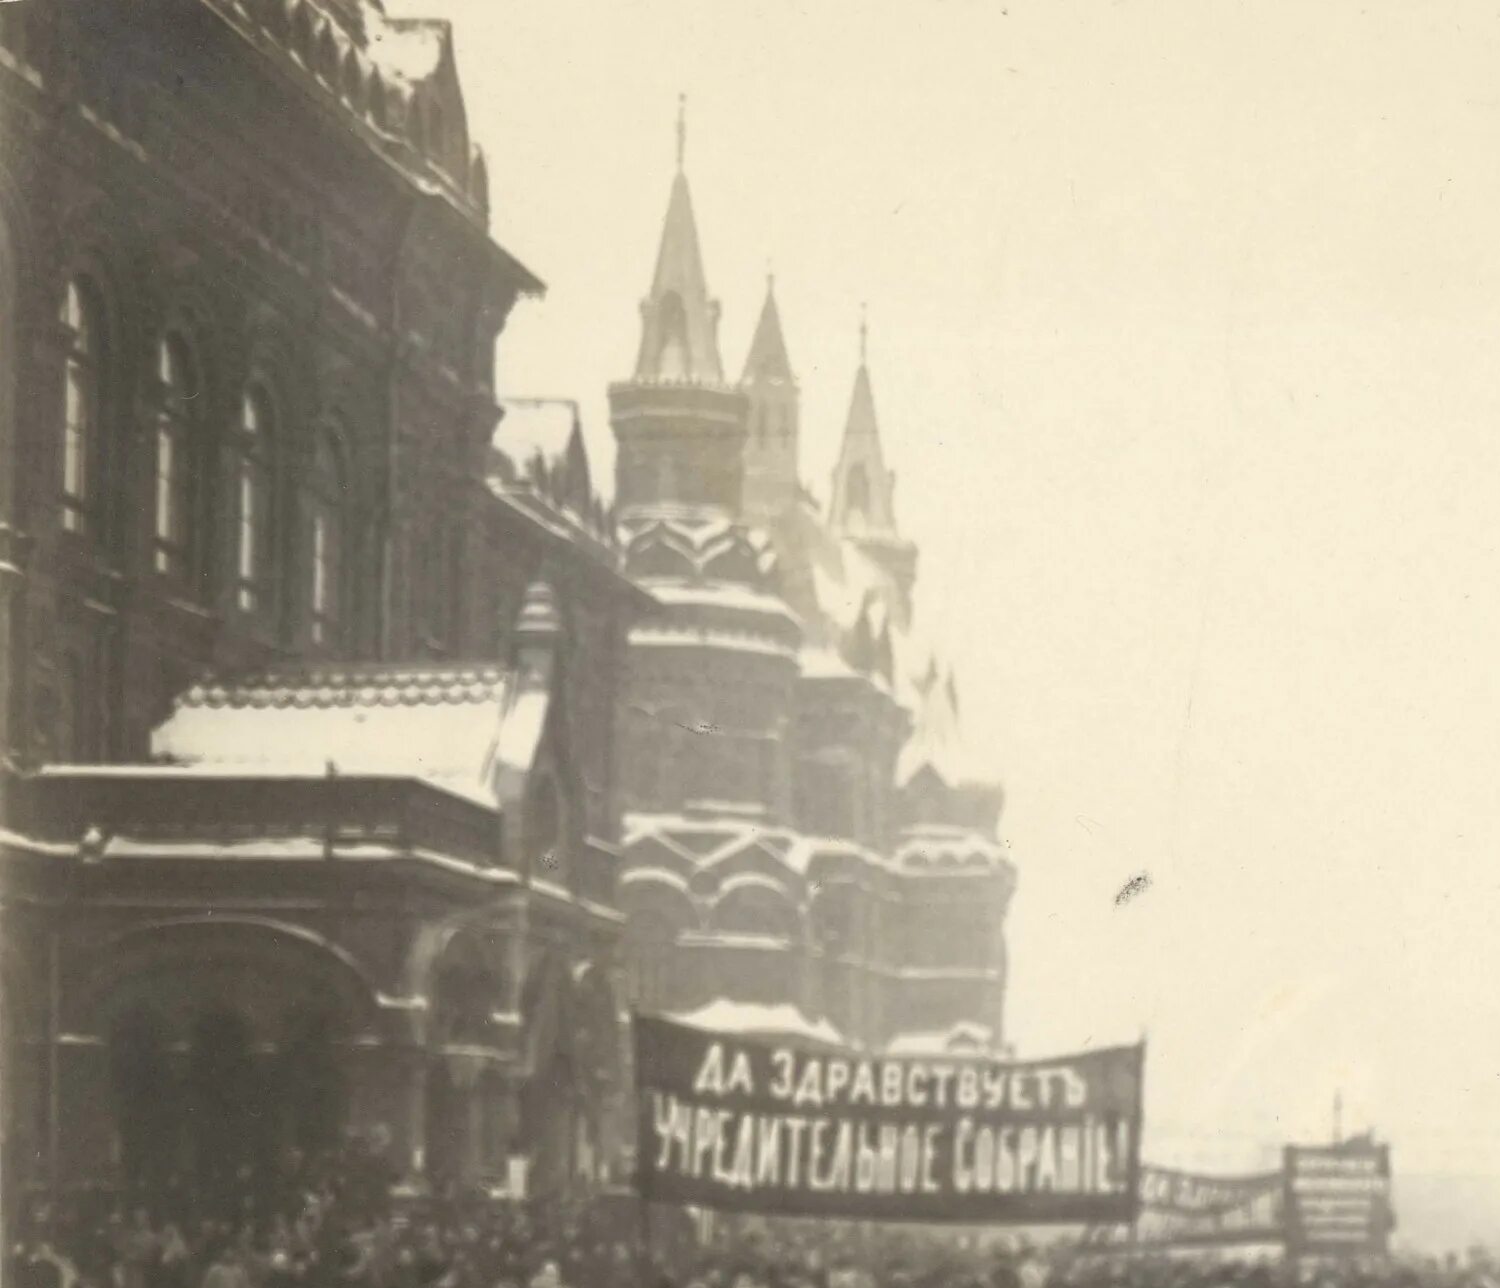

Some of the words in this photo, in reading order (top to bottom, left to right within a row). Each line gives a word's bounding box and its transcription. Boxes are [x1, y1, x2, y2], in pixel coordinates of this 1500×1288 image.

[694, 1042, 753, 1095] ДА
[770, 1050, 1088, 1110] ЗДРАВСТВУЕТЪ
[653, 1094, 941, 1192] УЧРЕДИТЕЛЬНОЕ
